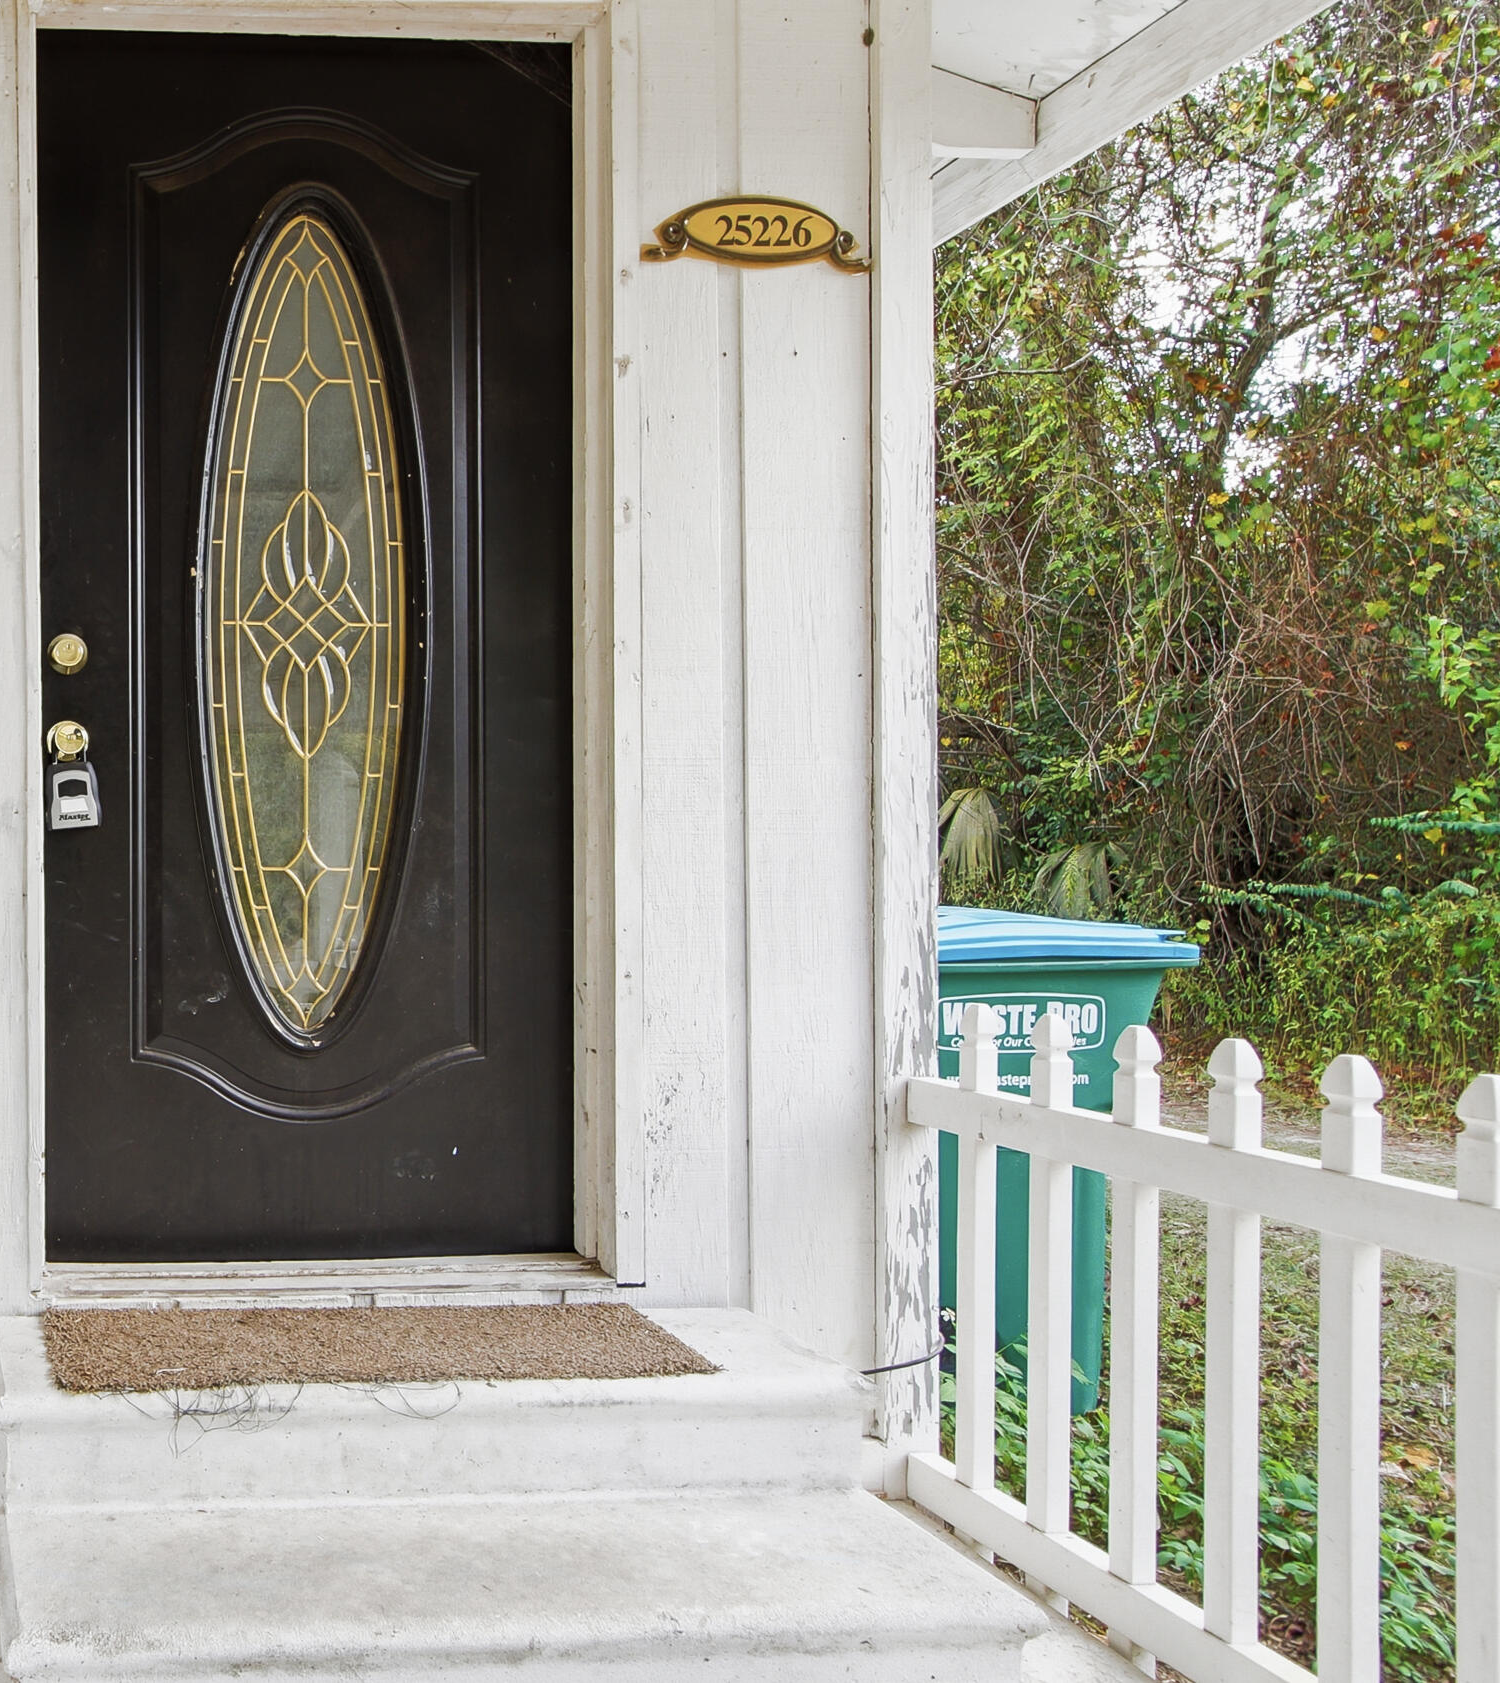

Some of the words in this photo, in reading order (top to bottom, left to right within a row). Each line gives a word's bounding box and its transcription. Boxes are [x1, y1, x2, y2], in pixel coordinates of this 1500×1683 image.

[715, 214, 813, 247] 25226
[942, 1002, 1037, 1036] WSTE
[1003, 1036, 1023, 1048] Our
